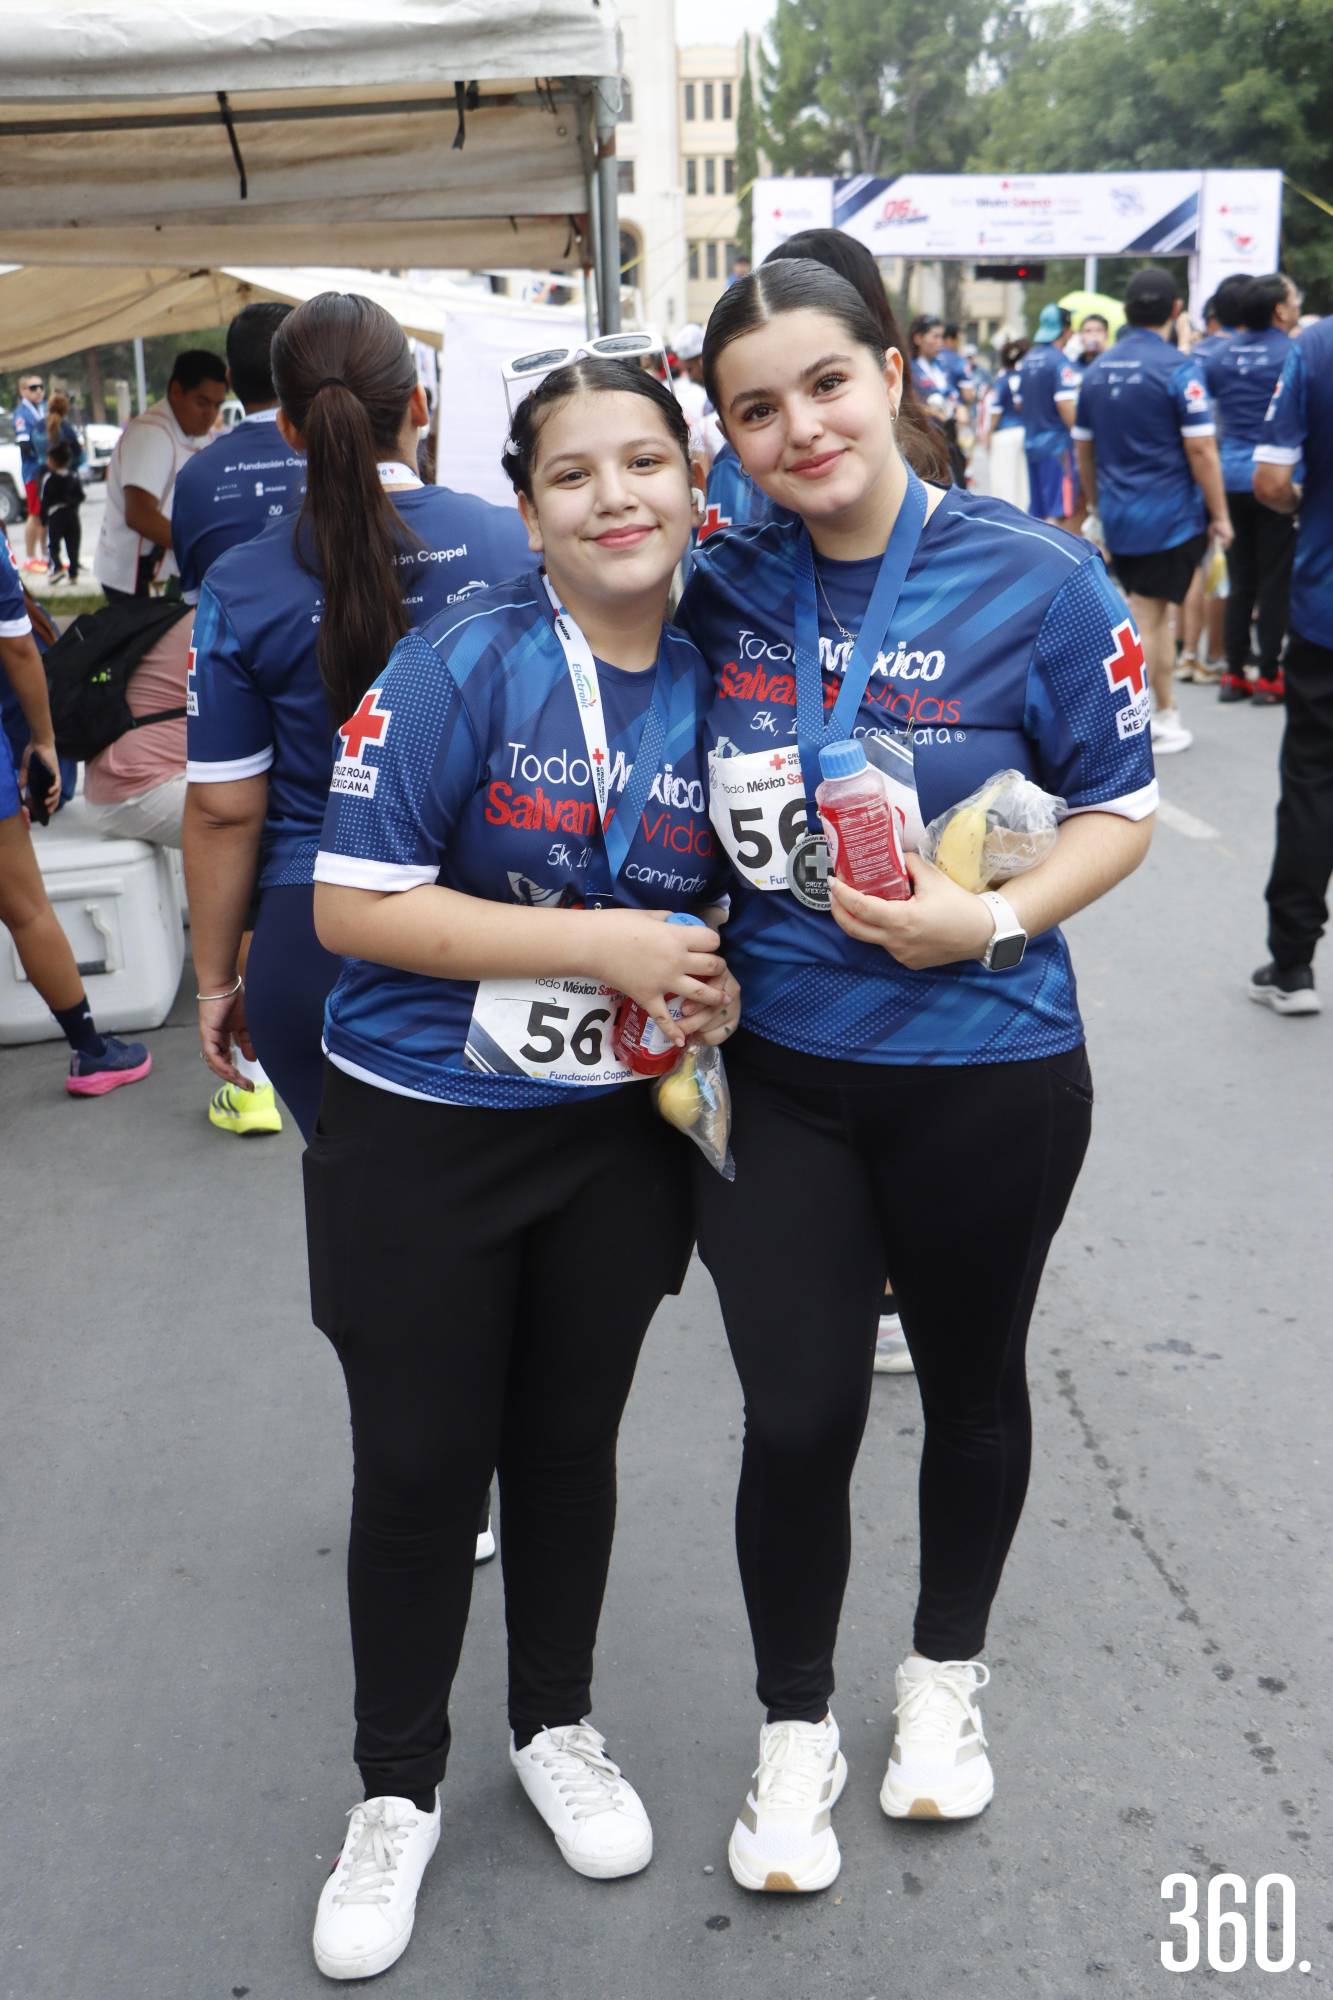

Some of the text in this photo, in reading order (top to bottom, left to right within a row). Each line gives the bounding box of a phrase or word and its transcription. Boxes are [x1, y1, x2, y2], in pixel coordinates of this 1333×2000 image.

[417, 544, 468, 564] Coppel
[818, 635, 946, 682] Mxico
[572, 663, 594, 709] Electrolit
[750, 711, 780, 736] 5k,
[331, 778, 369, 793] EXICANA
[347, 767, 371, 781] ROJA
[508, 742, 705, 813] Todo Mxico
[746, 777, 786, 793] México
[484, 780, 713, 857] Salvan Vida
[547, 843, 573, 871] 5k,
[562, 981, 598, 995] México
[520, 1001, 622, 1066] 56
[550, 1069, 633, 1082] Fundación Coppel
